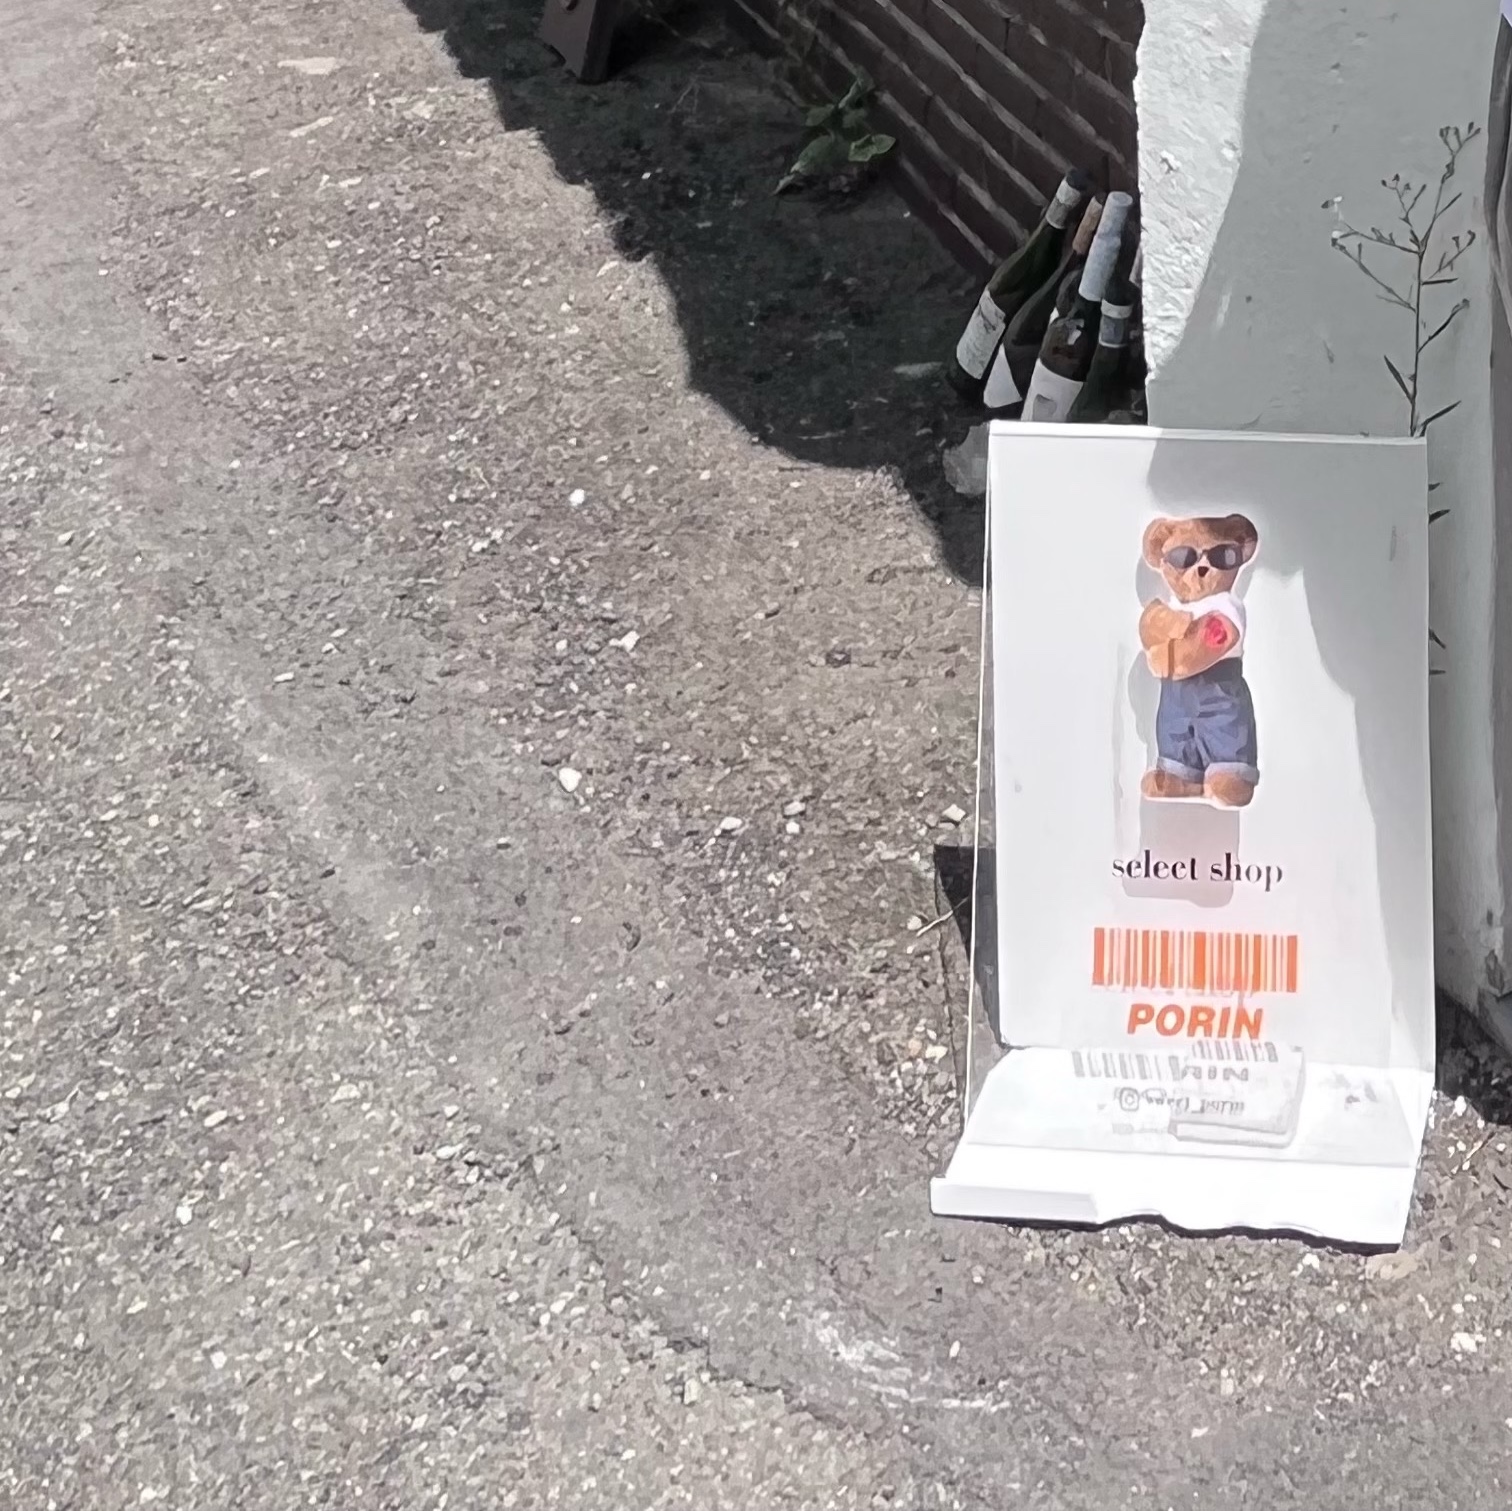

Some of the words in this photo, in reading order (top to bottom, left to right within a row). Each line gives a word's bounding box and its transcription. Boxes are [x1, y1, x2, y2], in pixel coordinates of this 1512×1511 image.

[1112, 849, 1199, 881] select
[1210, 852, 1283, 892] shop
[1127, 1003, 1264, 1039] PORIN
